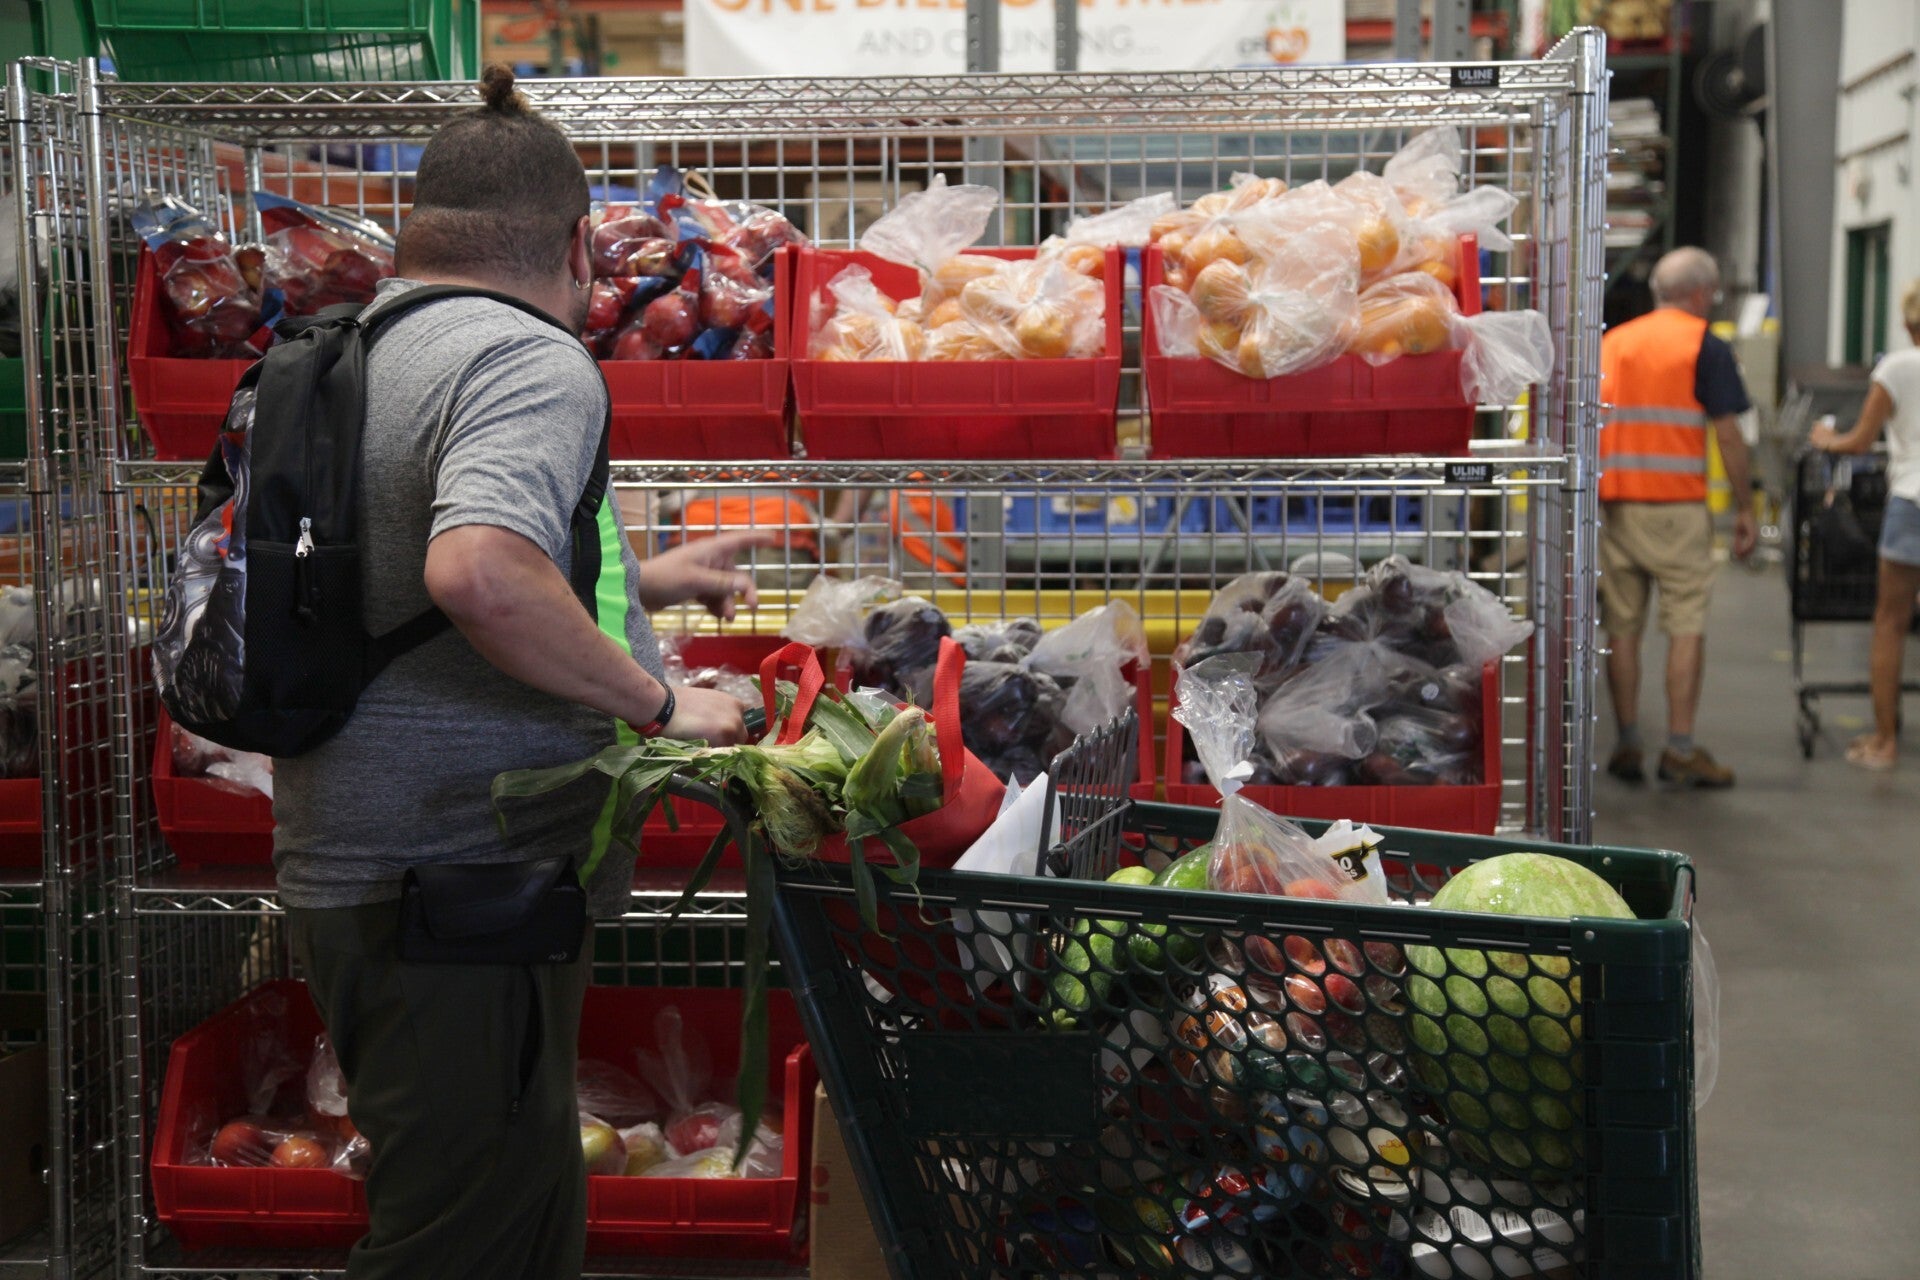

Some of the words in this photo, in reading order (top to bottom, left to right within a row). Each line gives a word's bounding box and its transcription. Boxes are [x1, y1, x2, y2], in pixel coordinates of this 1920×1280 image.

[855, 27, 935, 57] AND
[1458, 69, 1493, 79] ULINE
[1452, 466, 1487, 476] ULINE
